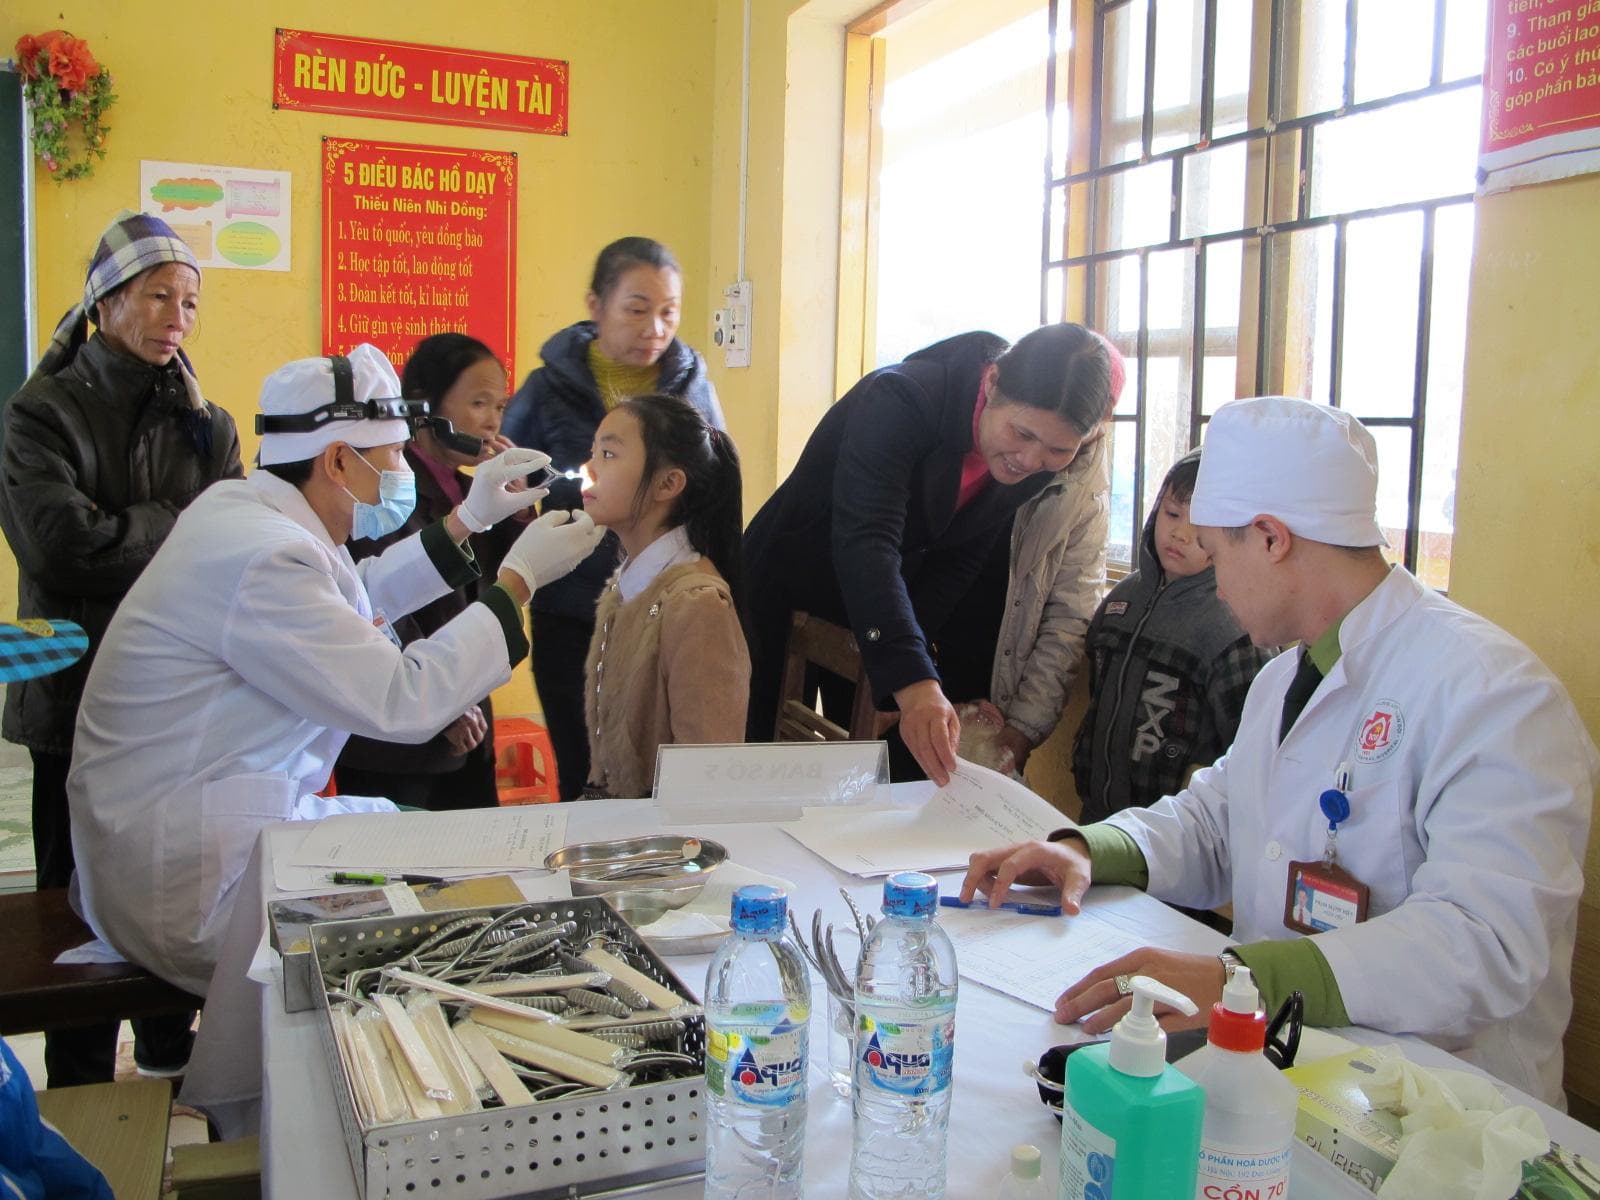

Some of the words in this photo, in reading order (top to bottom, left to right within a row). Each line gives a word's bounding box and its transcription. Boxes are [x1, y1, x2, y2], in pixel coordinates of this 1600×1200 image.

[1507, 23, 1521, 38] 9.
[1528, 10, 1572, 33] Tham
[1507, 44, 1534, 62] các
[1538, 26, 1571, 53] buổi
[1574, 26, 1599, 42] lao
[293, 48, 346, 93] RÈN
[354, 54, 405, 99] ĐỨC
[431, 68, 509, 116] LUYỆN
[516, 75, 552, 116] TÀI
[1507, 67, 1527, 85] 10.
[1534, 59, 1555, 78] Có
[1575, 47, 1600, 66] thứ
[1505, 90, 1533, 112] góp
[1535, 76, 1572, 103] phần
[1576, 68, 1600, 89] bả
[344, 162, 355, 185] 5
[359, 156, 397, 188] ĐIỀU
[402, 162, 434, 191] BÁC
[439, 162, 461, 192] HỒ
[465, 171, 497, 200] DẠY
[353, 194, 389, 211] Thiếu
[393, 198, 422, 213] Niên
[426, 200, 447, 215] Nhi
[451, 200, 488, 221] Đồng:
[338, 221, 347, 240] 1.
[350, 220, 369, 241] Yêu
[372, 217, 384, 242] tổ
[386, 221, 413, 247] quốc,
[416, 226, 434, 248] yêu
[465, 228, 484, 248] bào
[338, 252, 347, 271] 2.
[350, 252, 370, 278] Học
[373, 254, 390, 278] tập
[393, 253, 410, 276] tốt,
[413, 256, 428, 275] lao
[431, 257, 456, 281] động
[458, 256, 473, 278] tốt
[338, 283, 347, 302] 3.
[350, 283, 377, 303] Đoàn
[380, 282, 396, 304] kết
[399, 283, 417, 308] tốt,
[432, 286, 452, 311] luật
[455, 285, 469, 307] tốt
[338, 314, 347, 333] 4.
[350, 314, 369, 334] Giữ
[371, 316, 387, 338] gìn
[391, 317, 402, 340] vệ
[405, 317, 427, 336] sinh
[731, 1047, 802, 1087] Aqua
[862, 1031, 930, 1076] Aqua
[1203, 1183, 1260, 1200] CỒN
